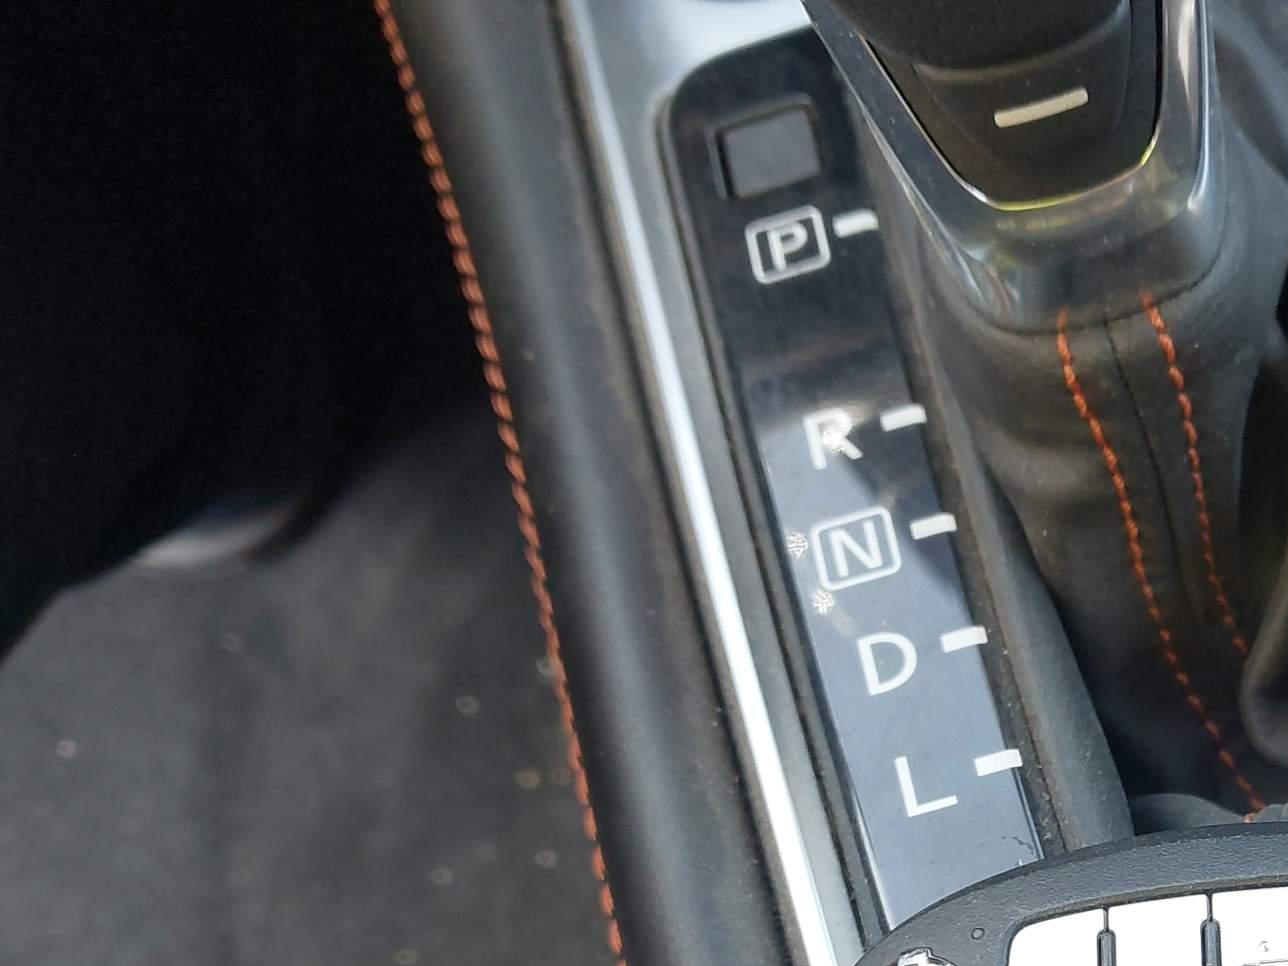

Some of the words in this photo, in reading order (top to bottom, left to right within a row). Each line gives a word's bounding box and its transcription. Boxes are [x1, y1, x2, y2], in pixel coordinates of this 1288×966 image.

[767, 221, 808, 272] P
[804, 410, 863, 470] R
[829, 520, 882, 574] N
[858, 630, 918, 696] D
[893, 756, 958, 818] L
